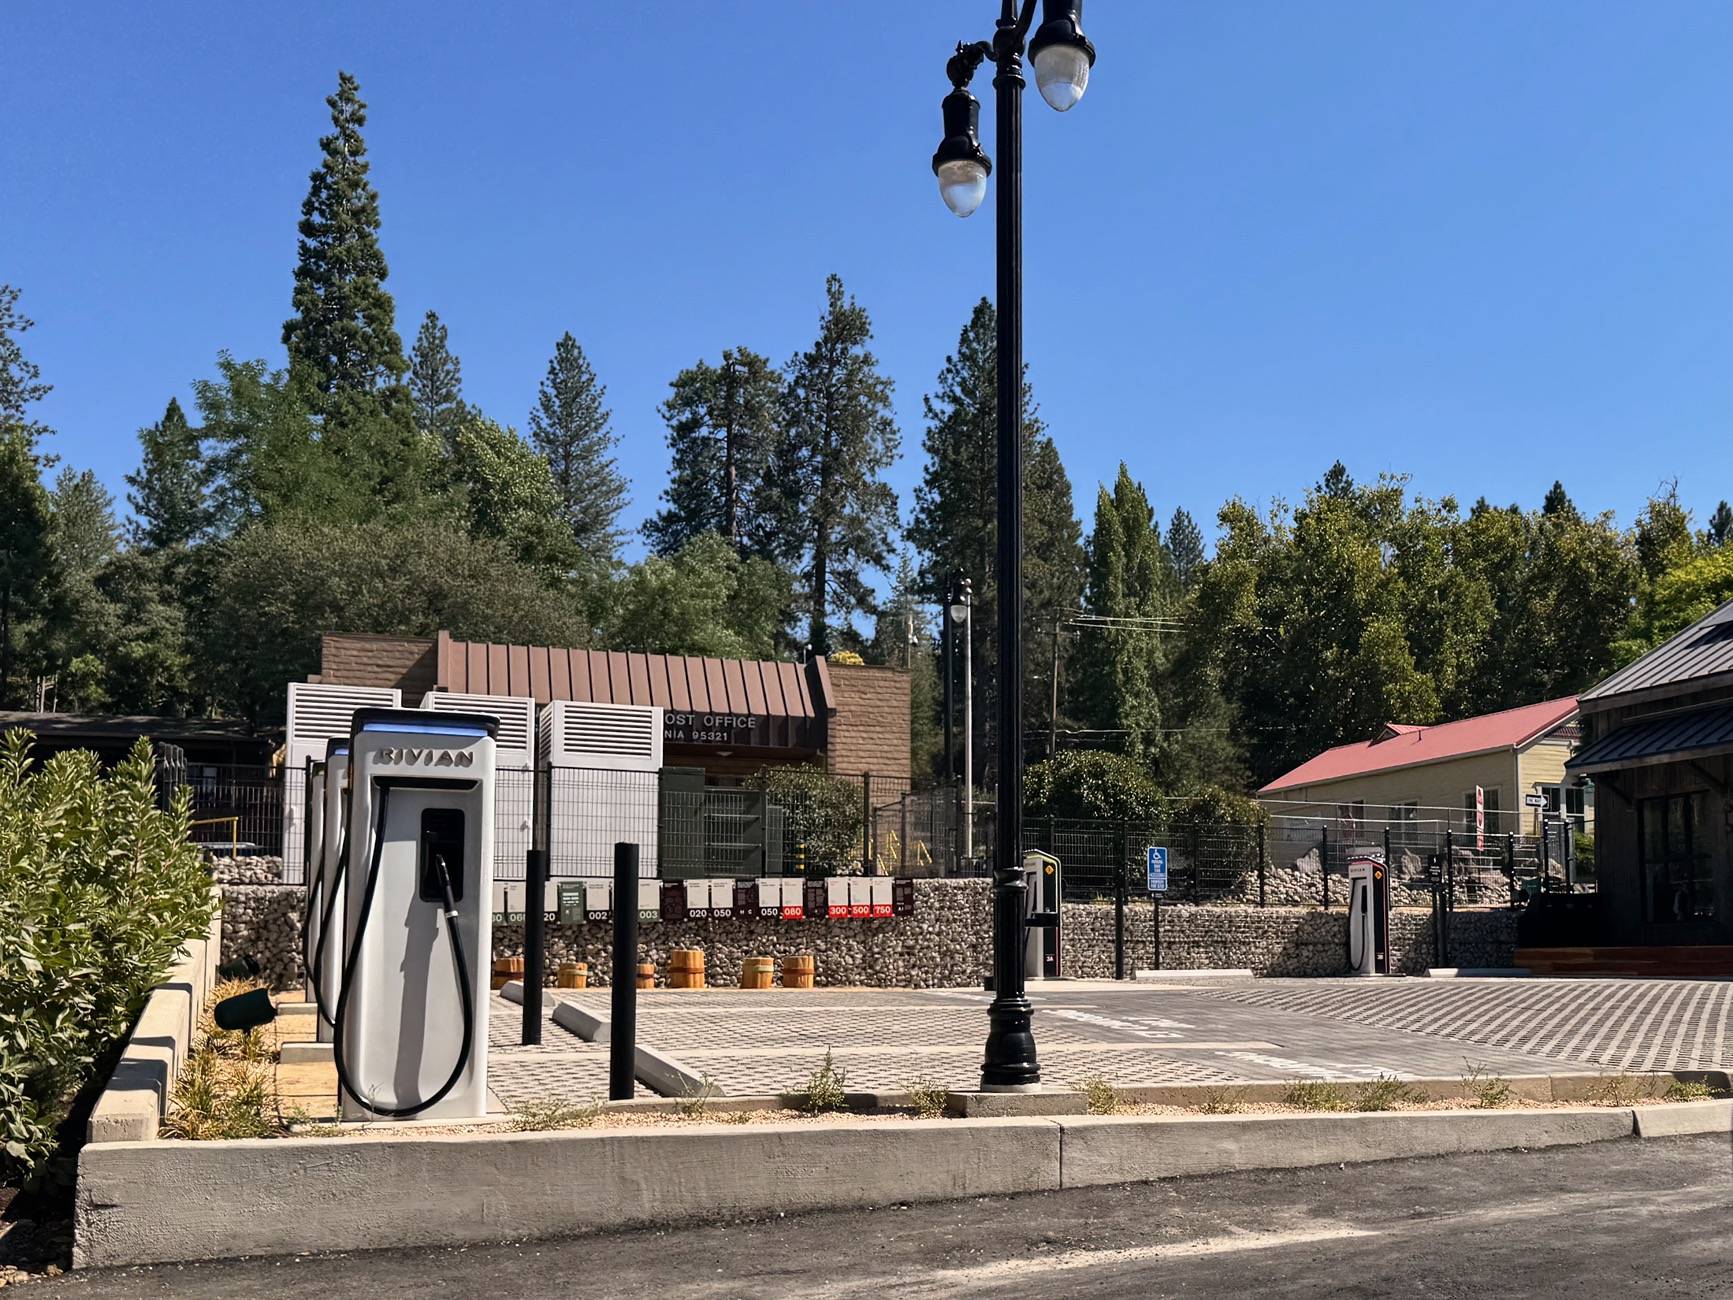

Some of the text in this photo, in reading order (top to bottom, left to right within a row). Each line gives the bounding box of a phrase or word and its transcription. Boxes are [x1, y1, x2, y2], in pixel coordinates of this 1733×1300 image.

[664, 713, 757, 729] OST OFFICE
[691, 731, 728, 741] 95321
[372, 747, 474, 768] RIVIAN
[689, 909, 707, 918] 020
[713, 909, 732, 918] 050
[761, 907, 778, 916] 050
[784, 907, 802, 916] 080
[830, 906, 847, 915] 300
[852, 906, 869, 914] 500
[874, 905, 891, 913] 750
[509, 913, 526, 922] 06
[588, 911, 608, 920] 002
[639, 910, 658, 919] 003
